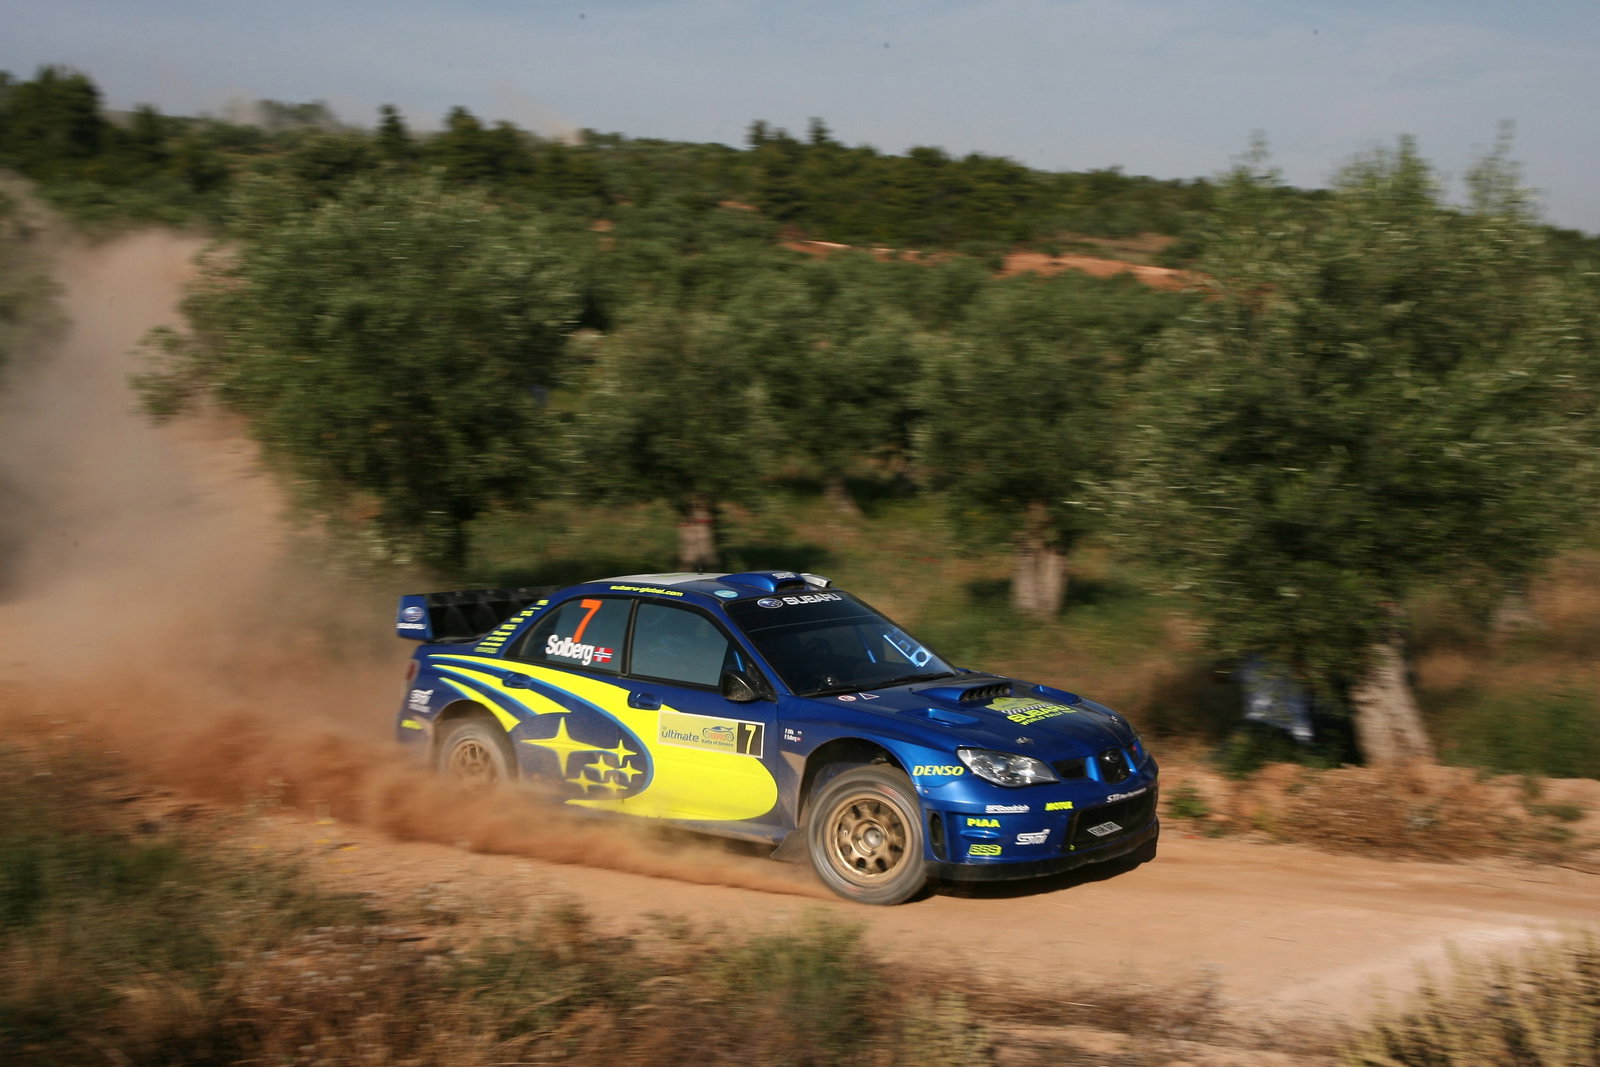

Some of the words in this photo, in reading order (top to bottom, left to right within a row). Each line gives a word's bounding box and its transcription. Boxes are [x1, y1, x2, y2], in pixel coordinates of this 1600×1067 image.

[782, 592, 842, 605] SUBARU
[575, 598, 603, 644] 7
[545, 634, 595, 666] Solberg
[661, 729, 700, 743] ultimate
[744, 724, 757, 754] 7
[912, 765, 965, 777] DENSO
[966, 817, 1001, 828] PIAA
